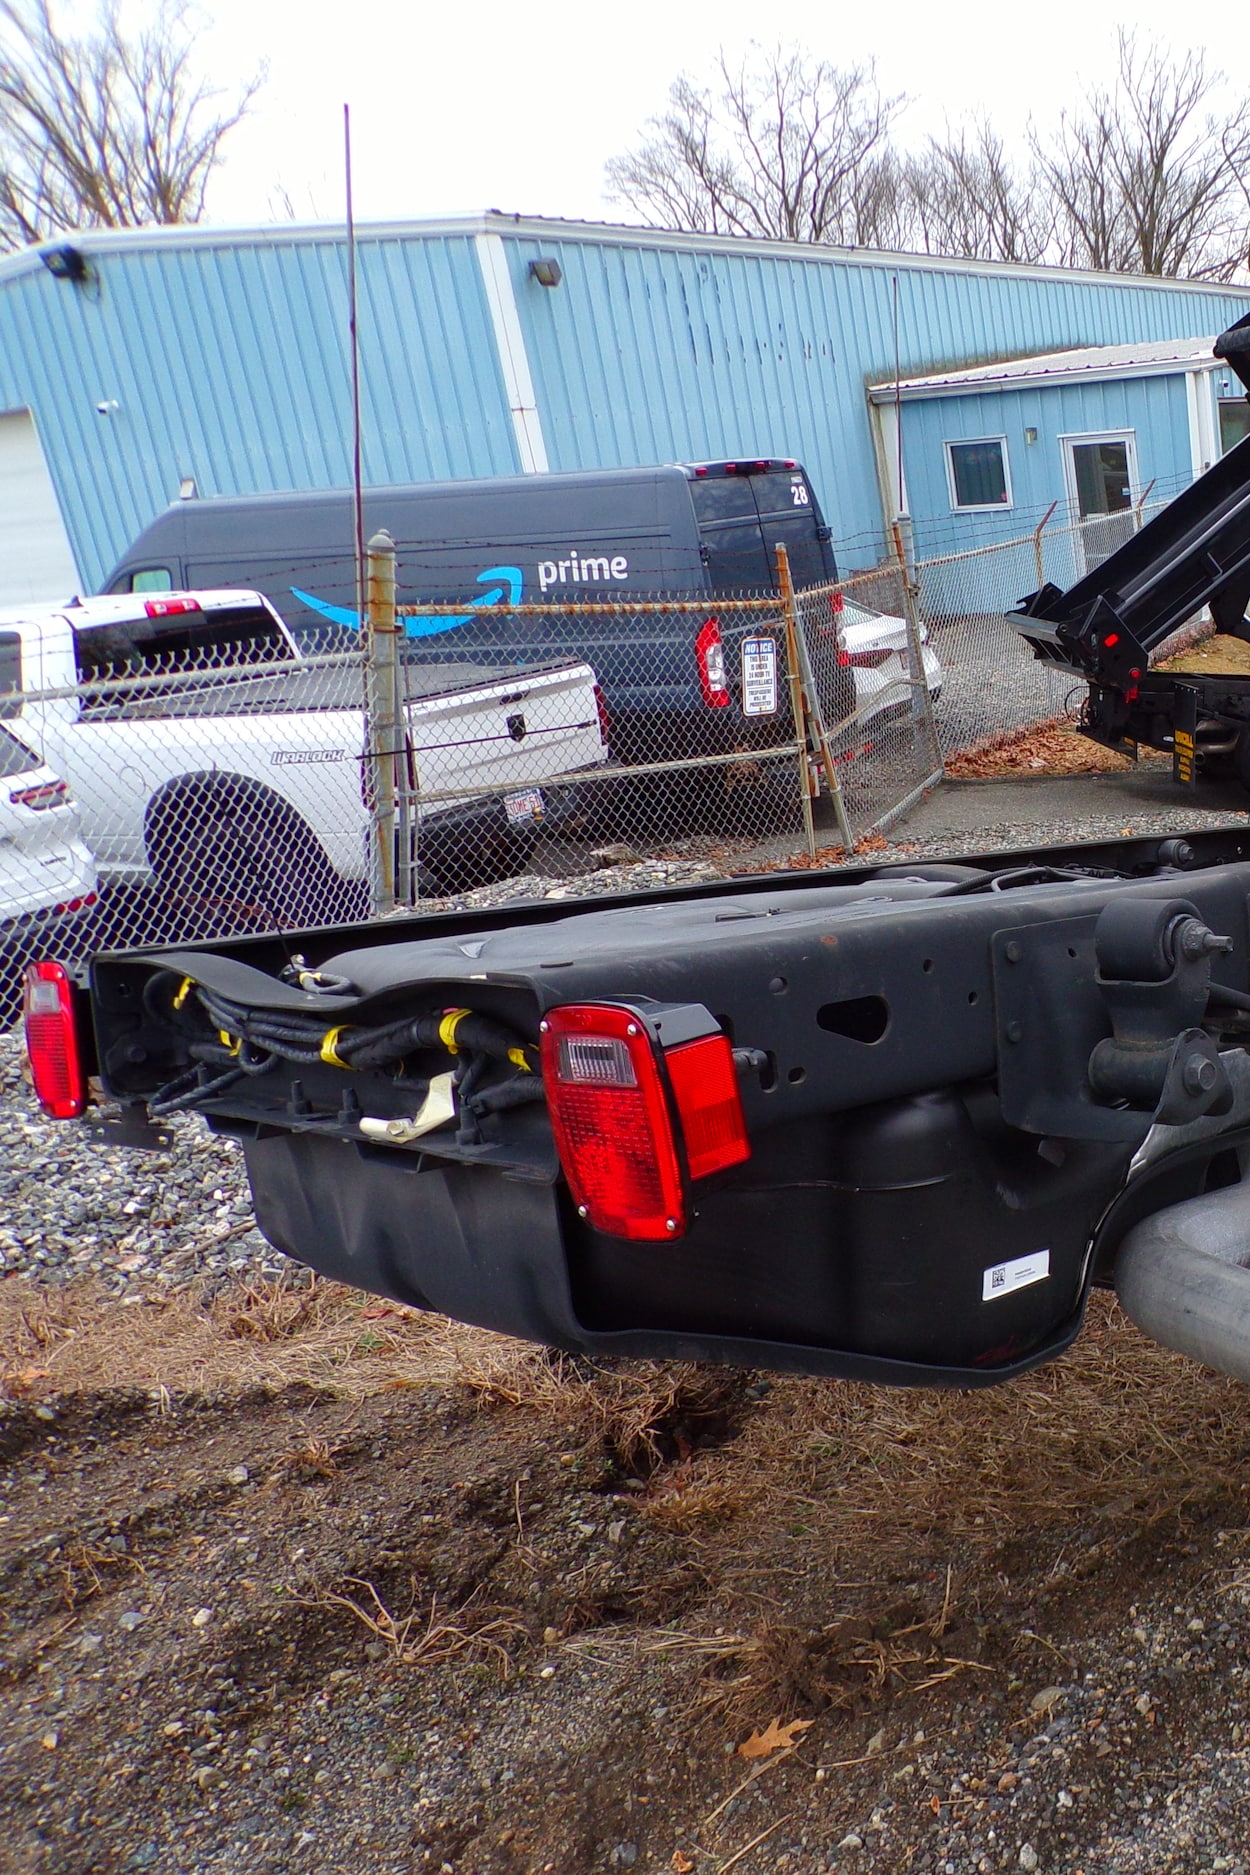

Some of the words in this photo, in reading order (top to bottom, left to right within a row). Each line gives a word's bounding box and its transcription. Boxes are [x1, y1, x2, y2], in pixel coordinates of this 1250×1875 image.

[791, 485, 808, 505] 28
[538, 551, 628, 592] prime
[745, 643, 772, 653] NOTICE
[271, 749, 344, 765] WARLOCK
